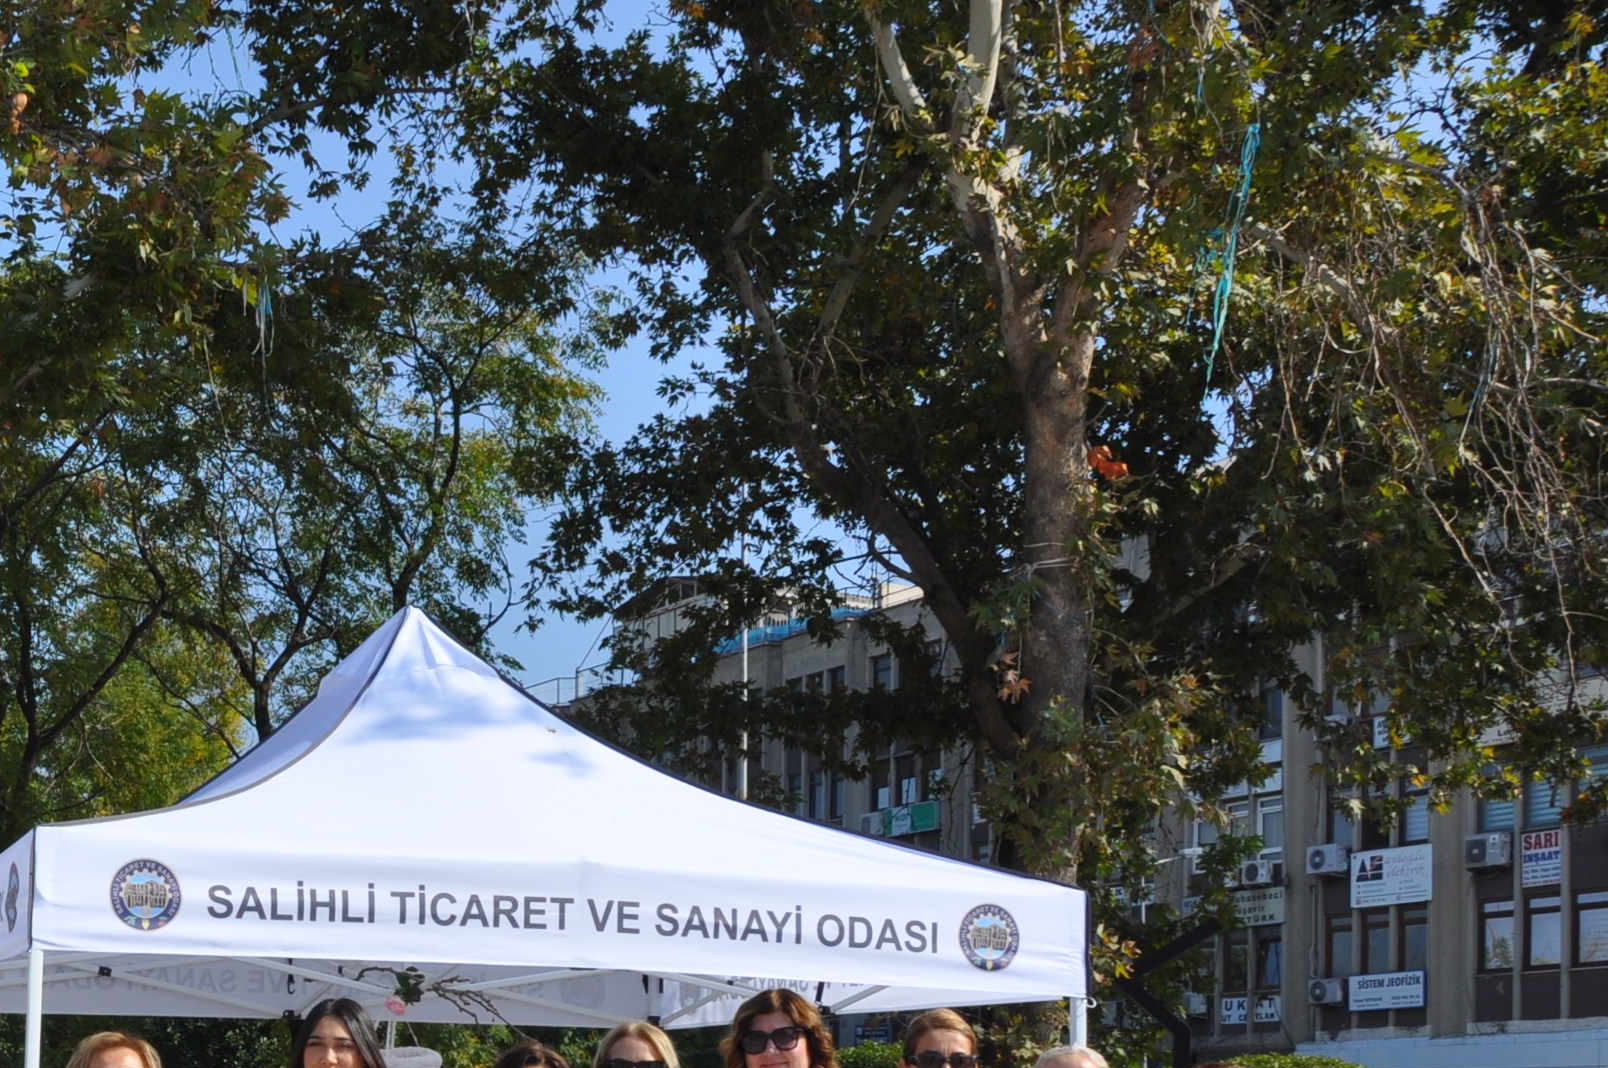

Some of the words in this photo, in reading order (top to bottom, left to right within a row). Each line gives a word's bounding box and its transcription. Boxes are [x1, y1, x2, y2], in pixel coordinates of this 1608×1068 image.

[1523, 831, 1559, 851] SARI
[1523, 850, 1560, 865] İNŞAAT
[145, 861, 156, 870] VE
[166, 890, 179, 916] ODASI
[207, 881, 375, 923] SALİHLİ
[391, 885, 574, 930] TİCARET
[588, 899, 639, 934] VE
[655, 904, 801, 944] SANAYİ
[817, 915, 937, 953] ODASI
[1246, 914, 1276, 923] TÜRK
[1357, 977, 1384, 990] SİSTEM
[1386, 974, 1421, 987] JEOFİZİK
